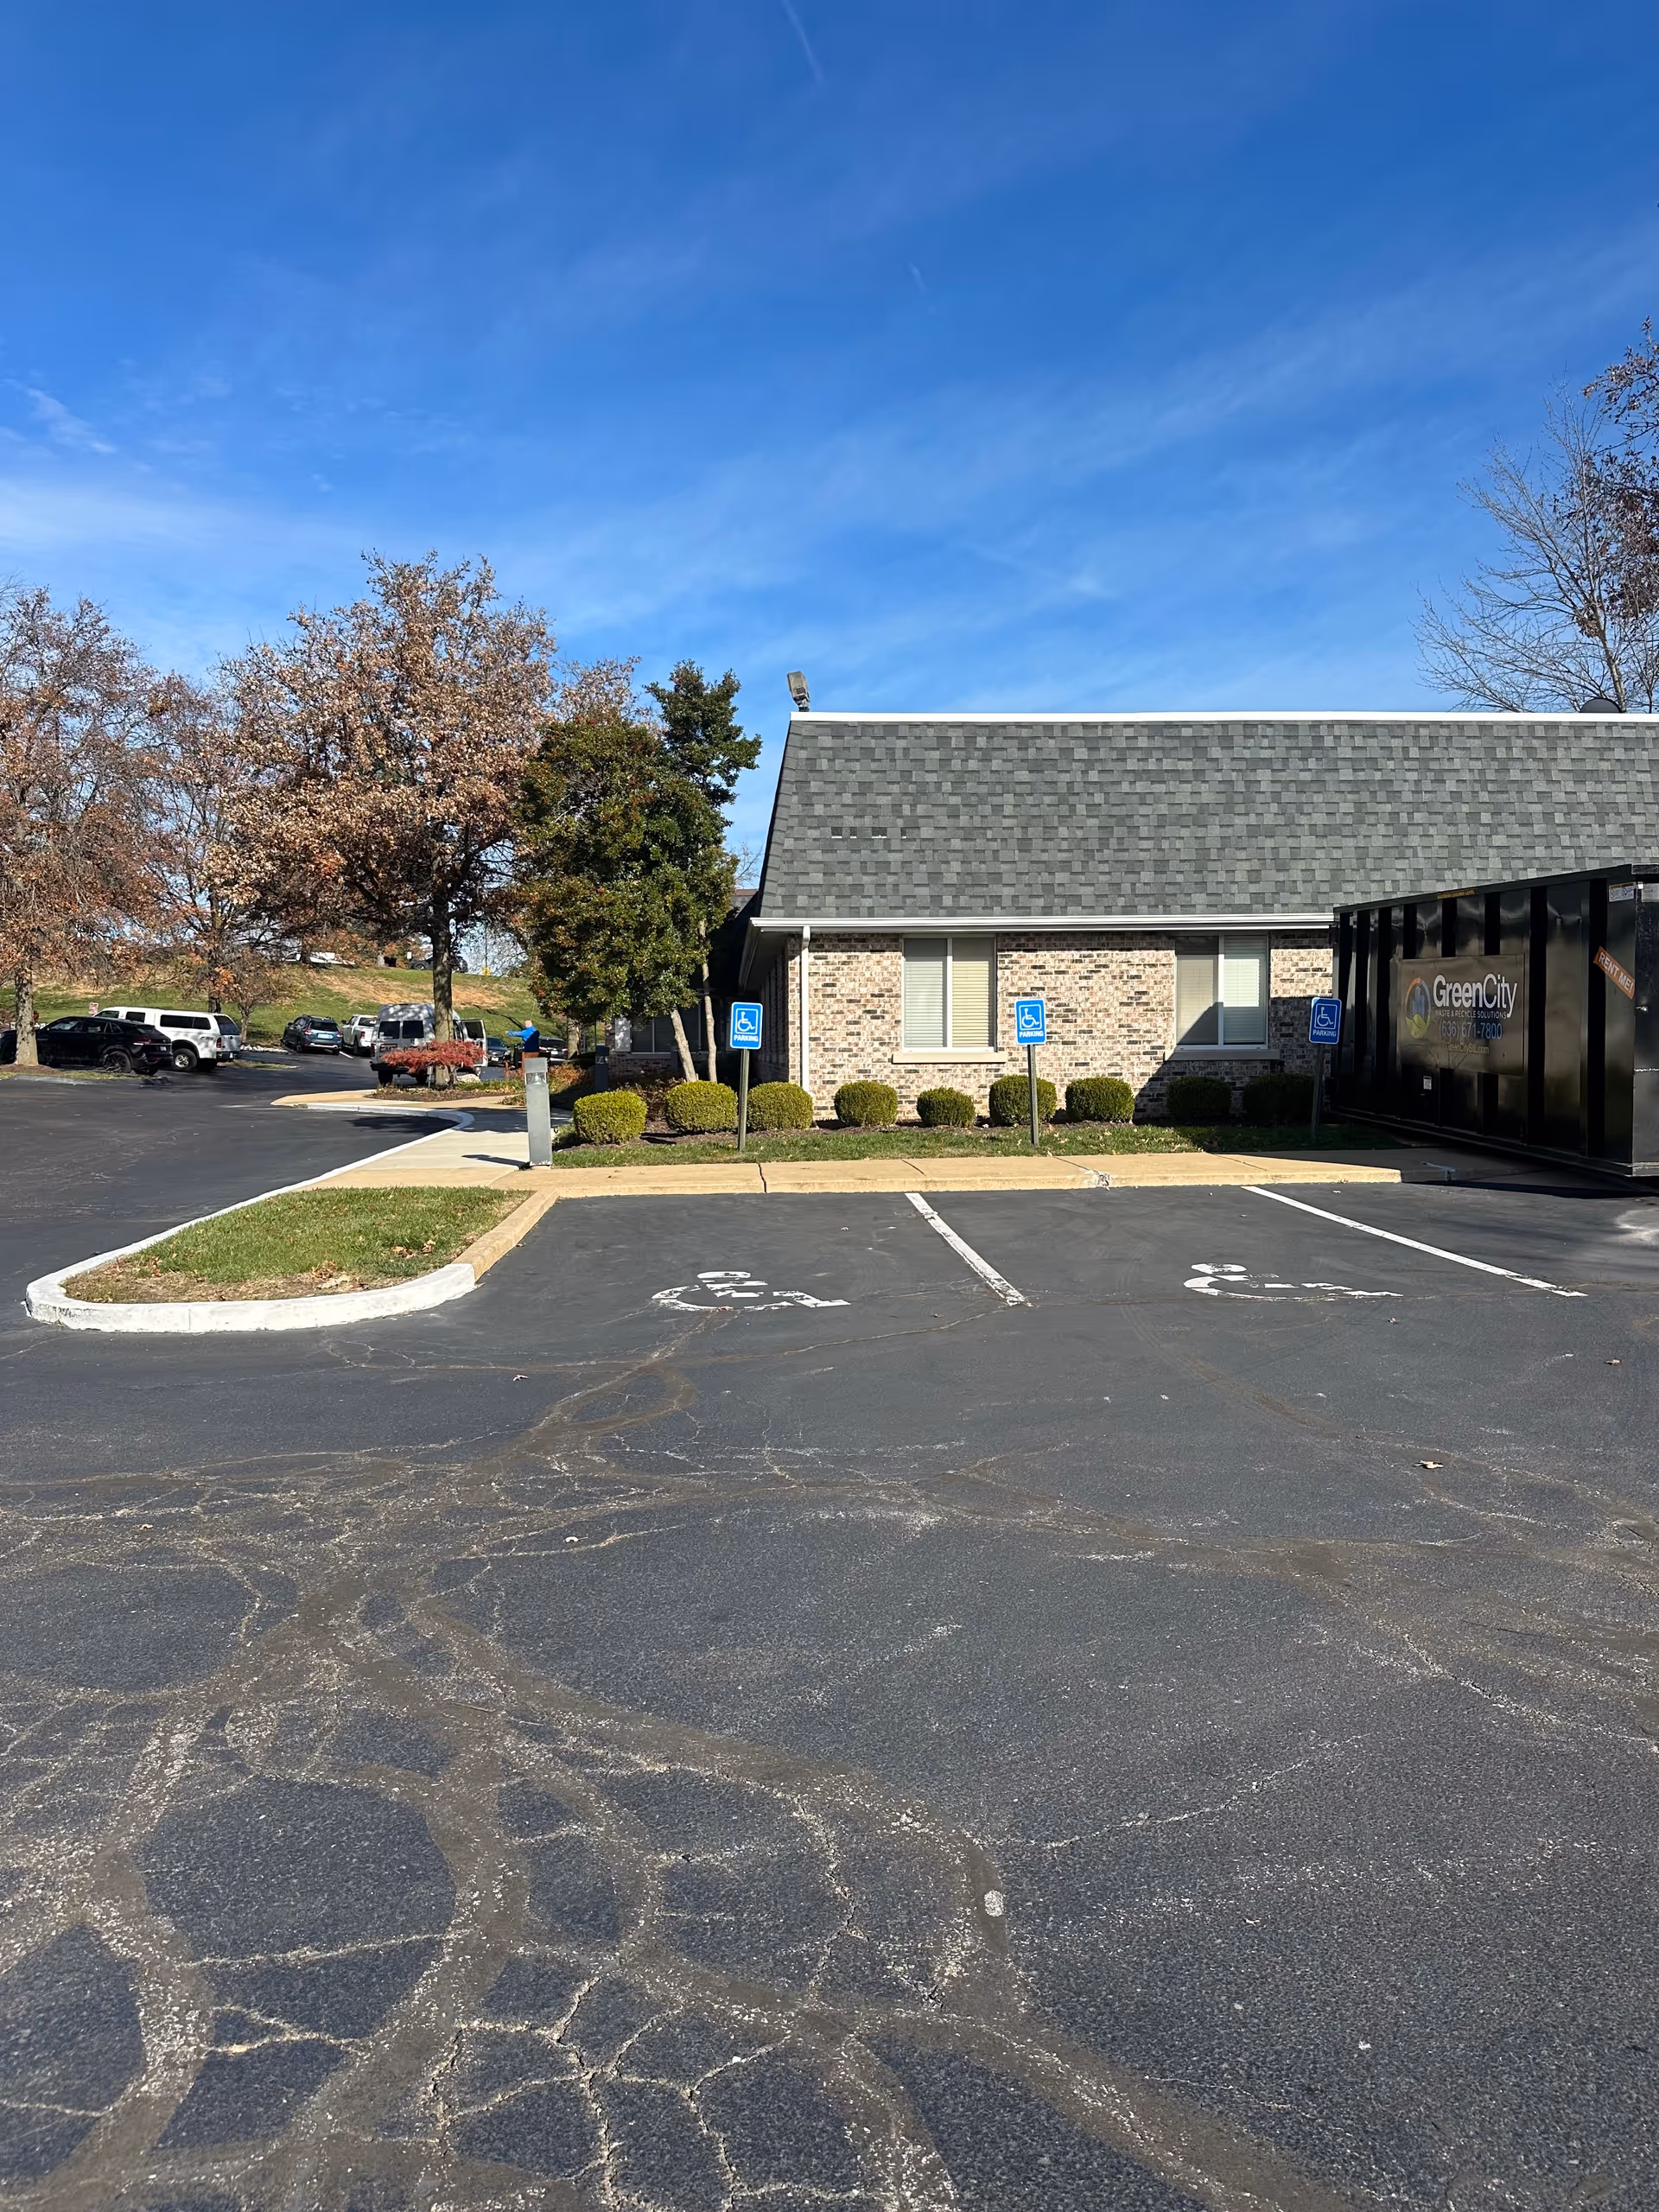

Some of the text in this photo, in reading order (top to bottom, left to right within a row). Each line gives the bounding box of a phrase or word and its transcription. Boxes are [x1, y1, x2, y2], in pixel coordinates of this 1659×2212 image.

[1599, 951, 1634, 993] RENT ME!
[1433, 973, 1518, 1019] GreenCity
[1439, 1020, 1503, 1040] (636) 671-7800
[1478, 1010, 1507, 1020] SOLUTIONS
